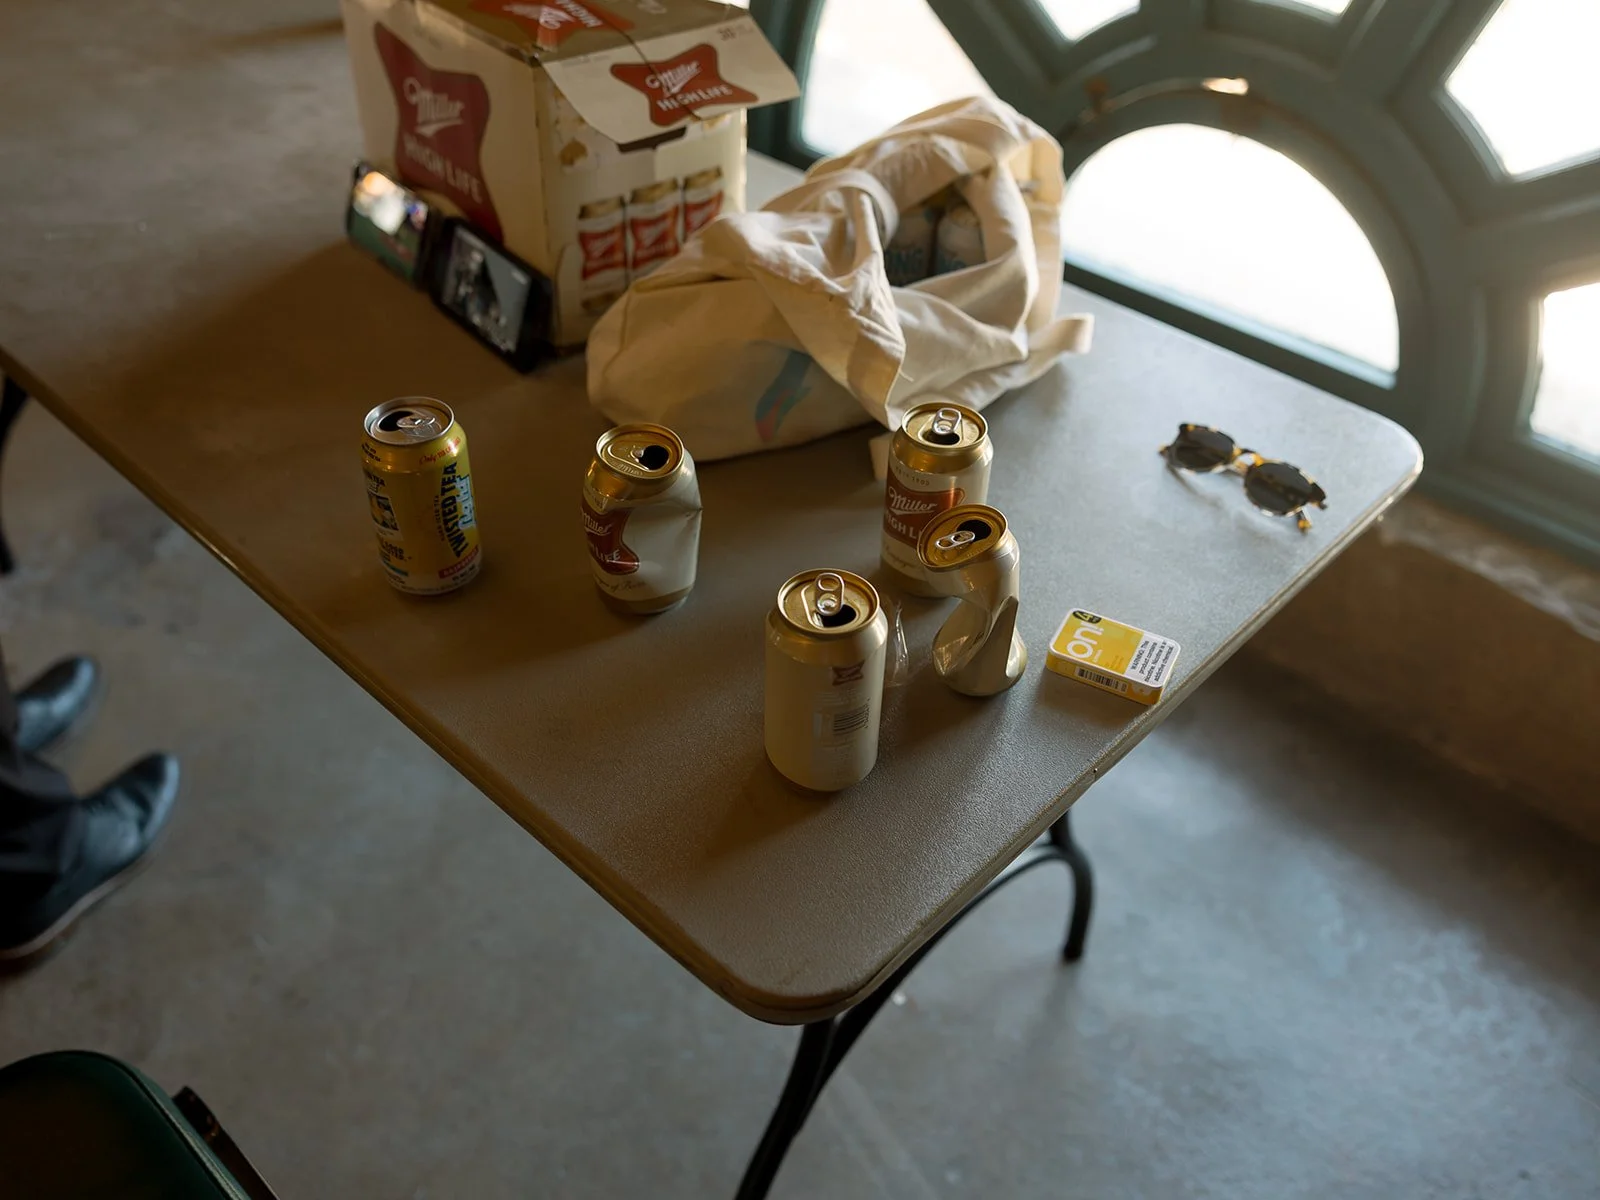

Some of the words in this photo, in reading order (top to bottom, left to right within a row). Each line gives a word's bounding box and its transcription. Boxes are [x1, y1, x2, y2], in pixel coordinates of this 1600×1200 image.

[644, 60, 703, 98] Miller
[656, 91, 700, 112] HIGH
[696, 83, 733, 101] LIFE
[402, 76, 465, 138] Miller
[403, 131, 446, 180] HIGH
[445, 157, 483, 205] LIFE
[441, 462, 457, 495] TEA
[888, 486, 938, 516] Miller
[440, 494, 469, 558] TWISTED
[1066, 620, 1104, 659] on!
